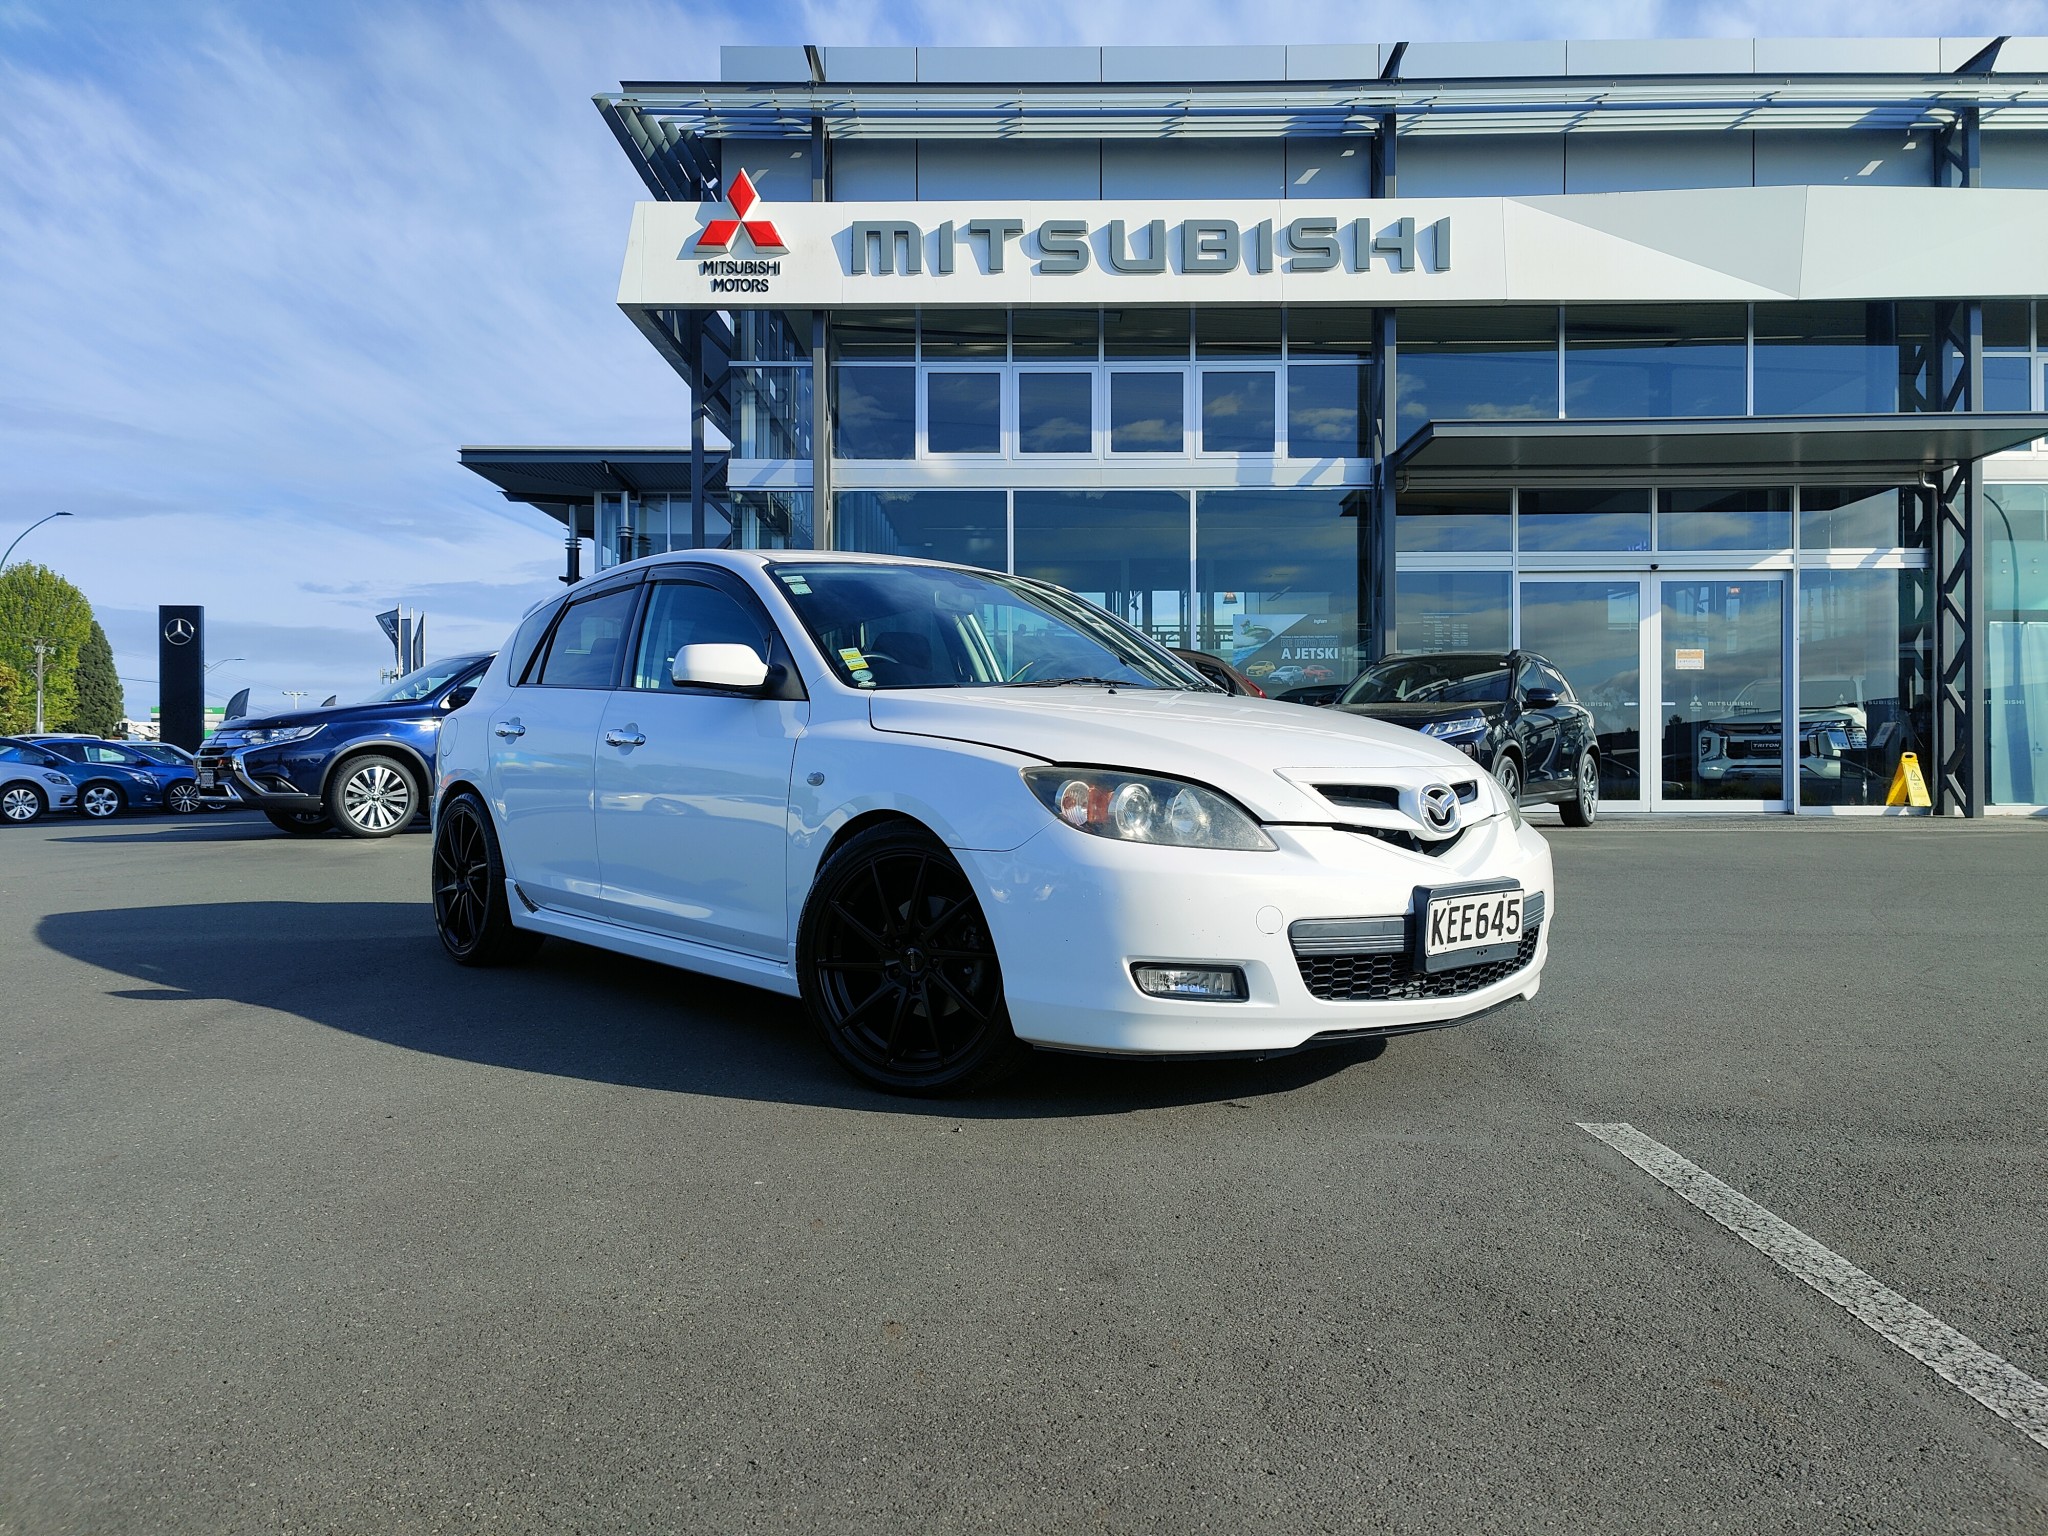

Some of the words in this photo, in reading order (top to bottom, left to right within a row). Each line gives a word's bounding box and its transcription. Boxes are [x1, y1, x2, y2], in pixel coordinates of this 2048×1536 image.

[851, 215, 1452, 275] MITSUBISHI
[702, 260, 781, 275] MITSUBISHI
[712, 278, 770, 293] MOTORS
[1281, 647, 1292, 660] A
[1295, 647, 1339, 660] JETSKI
[1431, 898, 1520, 948] KEE645
